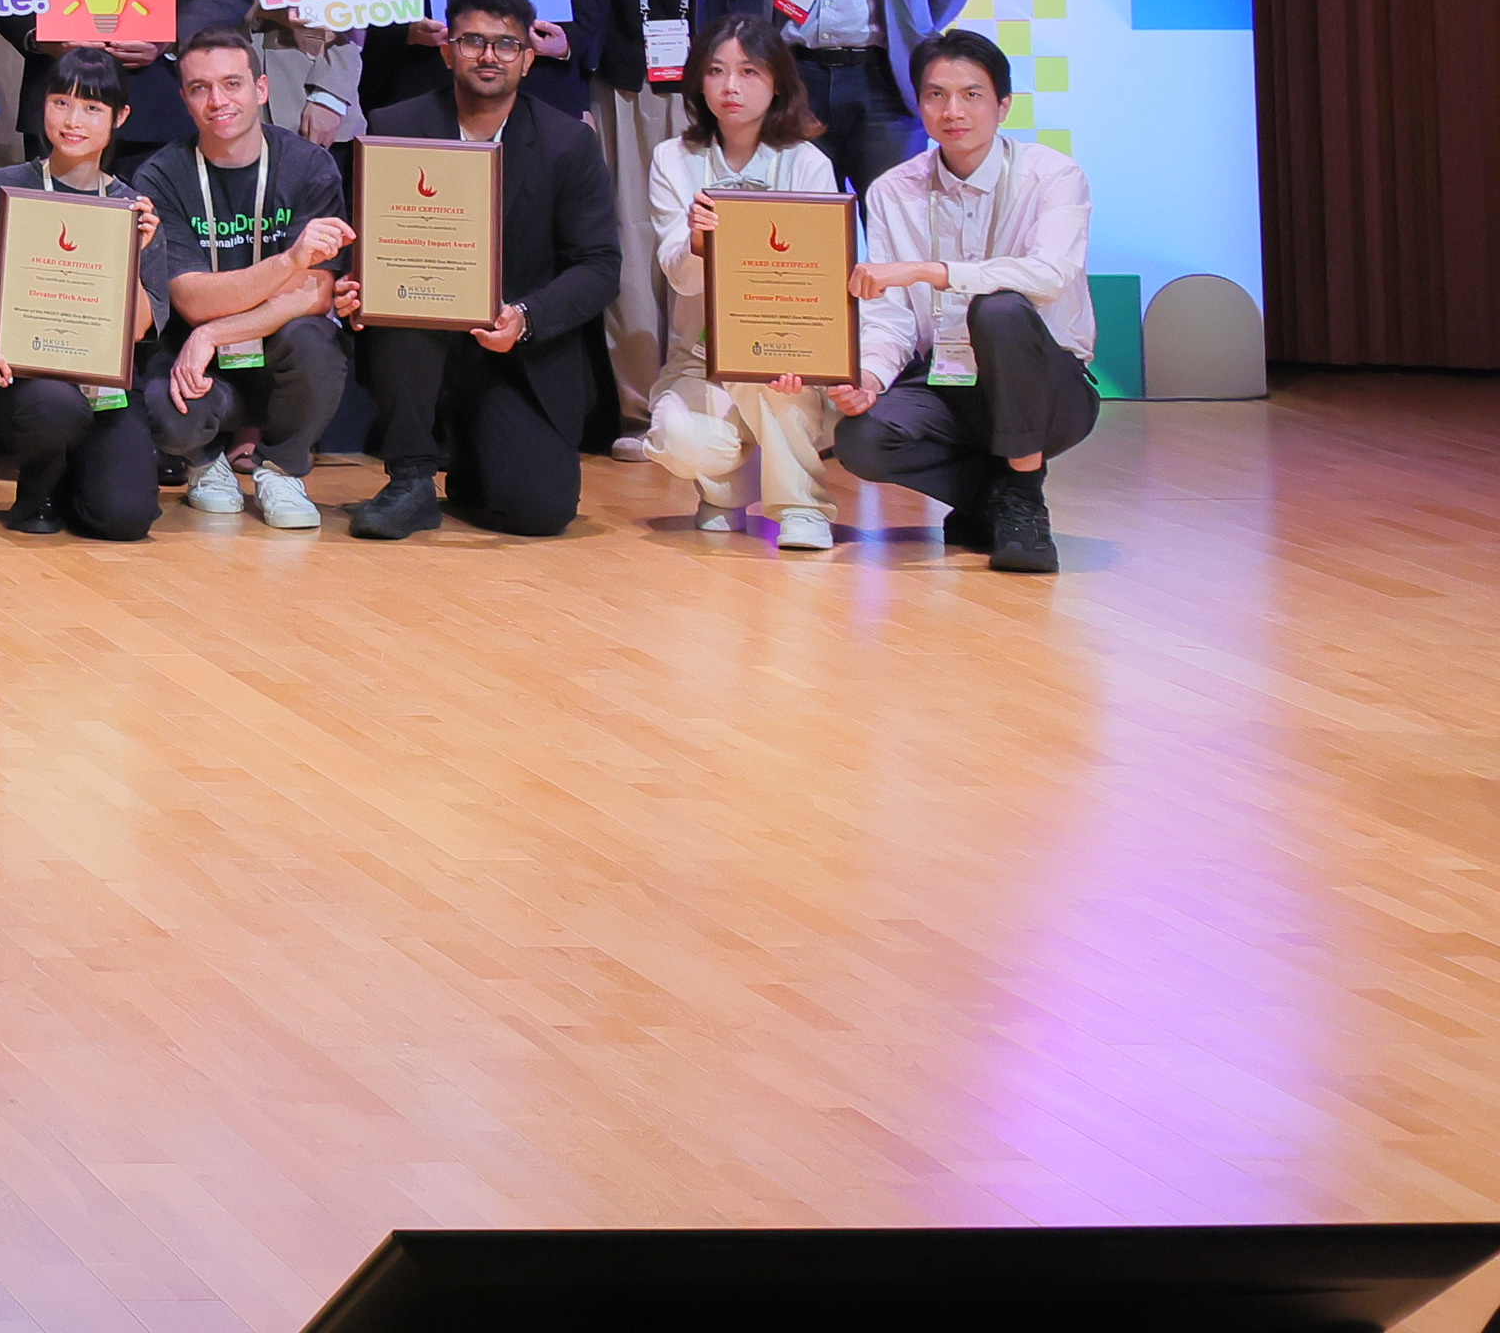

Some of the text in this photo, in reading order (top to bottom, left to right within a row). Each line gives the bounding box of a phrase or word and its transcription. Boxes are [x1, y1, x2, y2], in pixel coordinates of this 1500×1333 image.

[378, 237, 426, 248] Sustainability
[427, 239, 452, 249] Impact
[29, 289, 99, 303] Elevator Pitch Award
